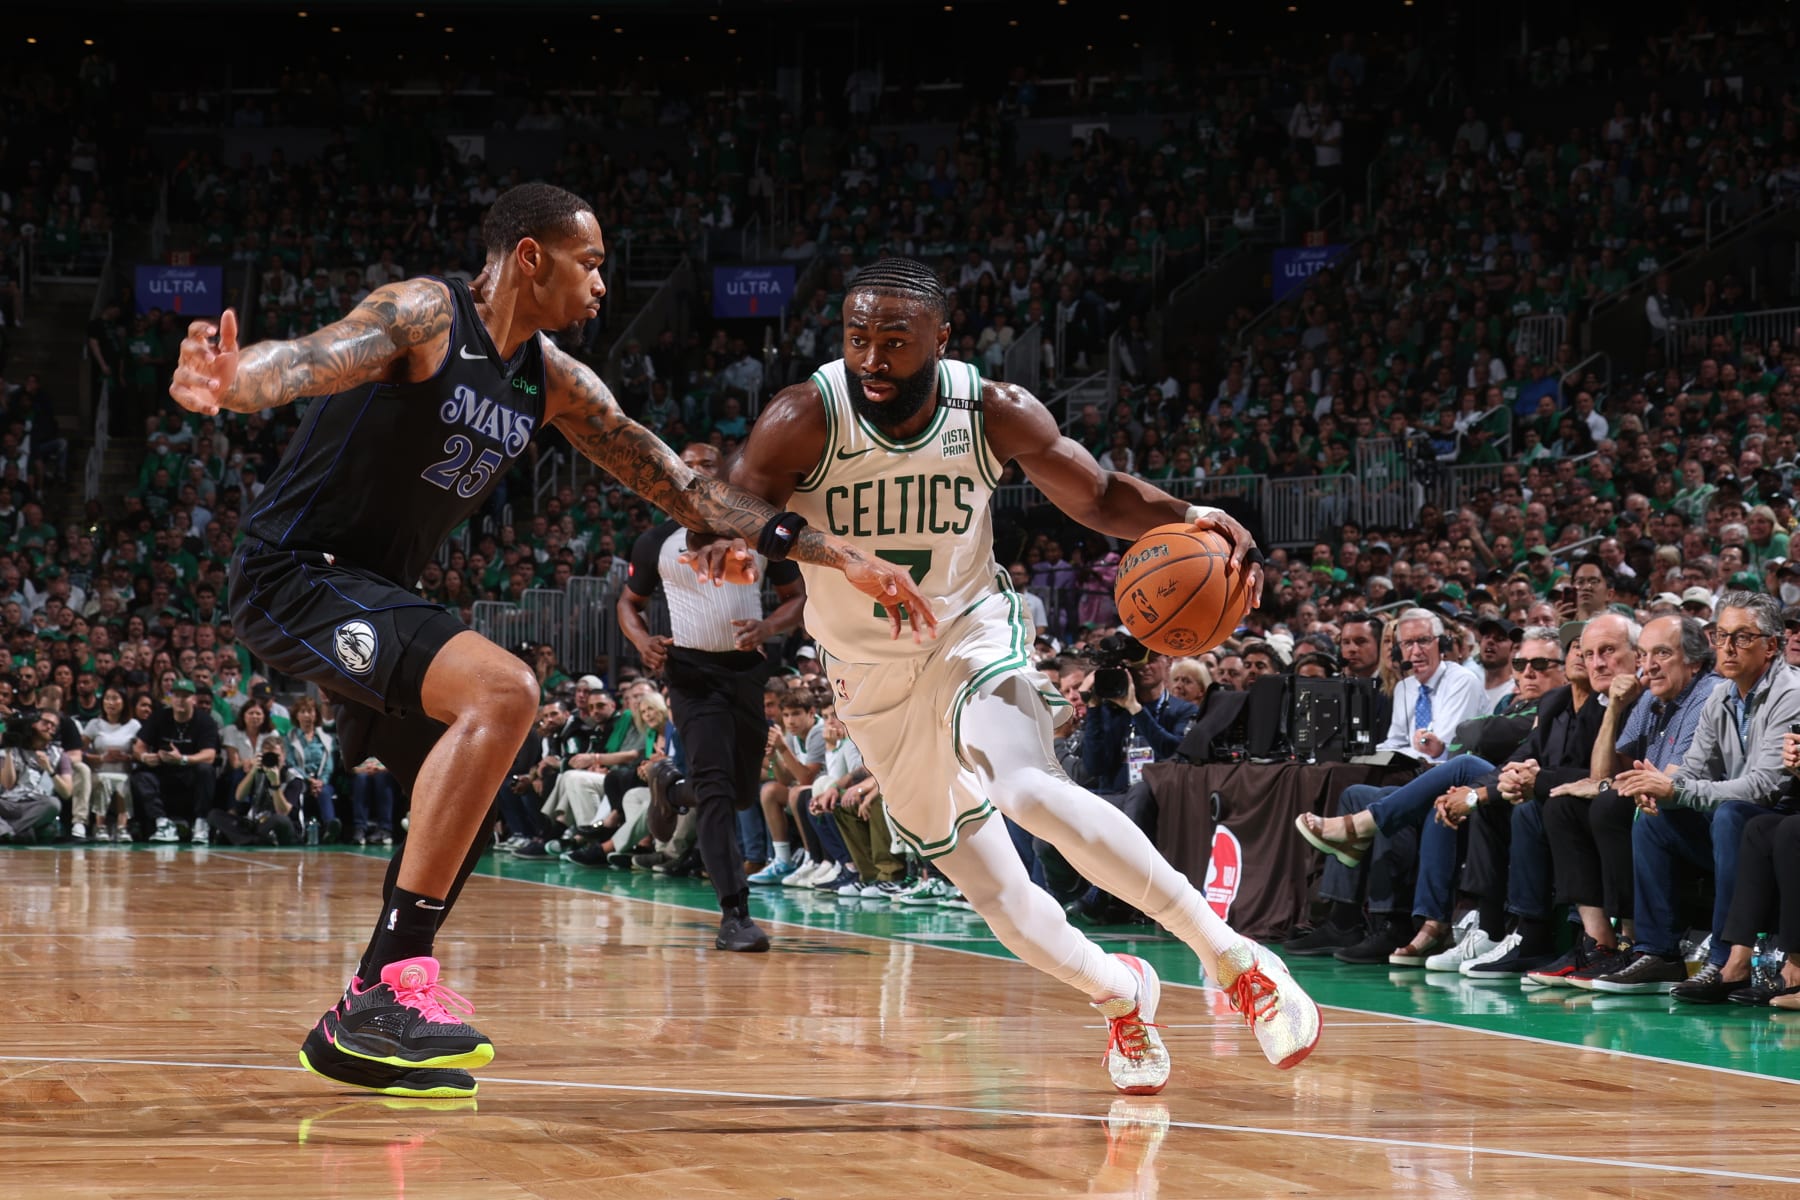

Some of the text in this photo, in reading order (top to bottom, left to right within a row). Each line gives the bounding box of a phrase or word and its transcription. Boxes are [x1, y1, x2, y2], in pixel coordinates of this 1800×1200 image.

[149, 279, 207, 293] ULTRA
[726, 281, 781, 295] ULTRA
[946, 398, 975, 410] WALTON
[439, 383, 536, 458] MAVS
[941, 428, 970, 446] VISTA
[942, 442, 971, 458] PRINT
[420, 434, 503, 498] 25
[826, 474, 974, 537] CELTICS
[873, 549, 932, 621] 7
